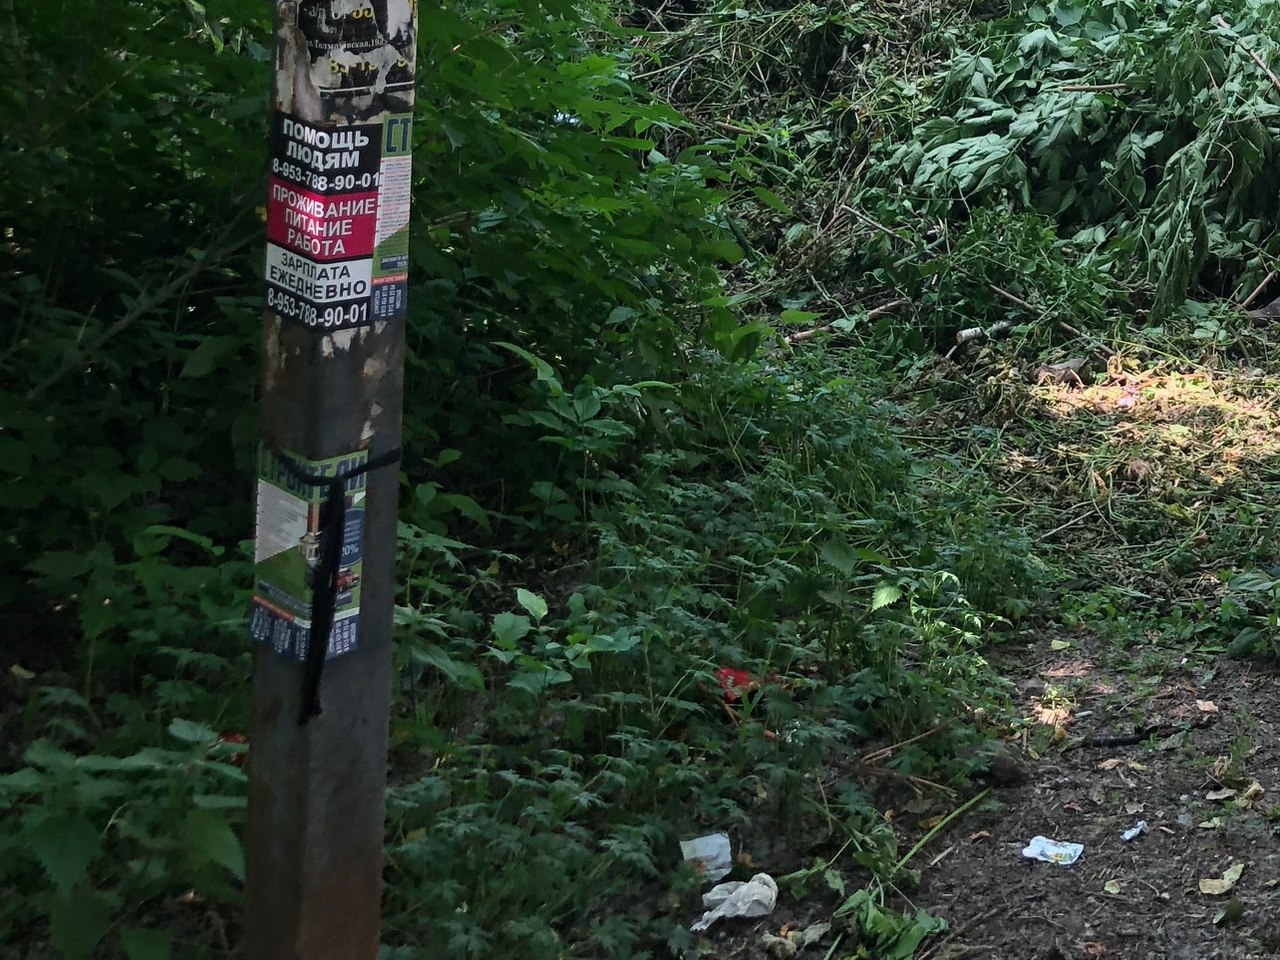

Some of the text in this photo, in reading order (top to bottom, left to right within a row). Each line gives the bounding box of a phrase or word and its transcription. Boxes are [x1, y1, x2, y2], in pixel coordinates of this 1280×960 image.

[283, 118, 370, 150] ПОМОЩЬ
[286, 141, 360, 171] ЛЮДЯМ
[272, 158, 380, 191] 8-953-788-90-01
[273, 184, 376, 219] ПРОЖИВАНИЕ
[285, 208, 353, 238] ПИТАНИЕ
[287, 230, 346, 257] РАБОТА
[281, 252, 351, 281] ЗАРПЛАТА
[270, 266, 367, 301] ЕЖЕДНЕВНО
[267, 287, 368, 328] 8-953-788-90-01
